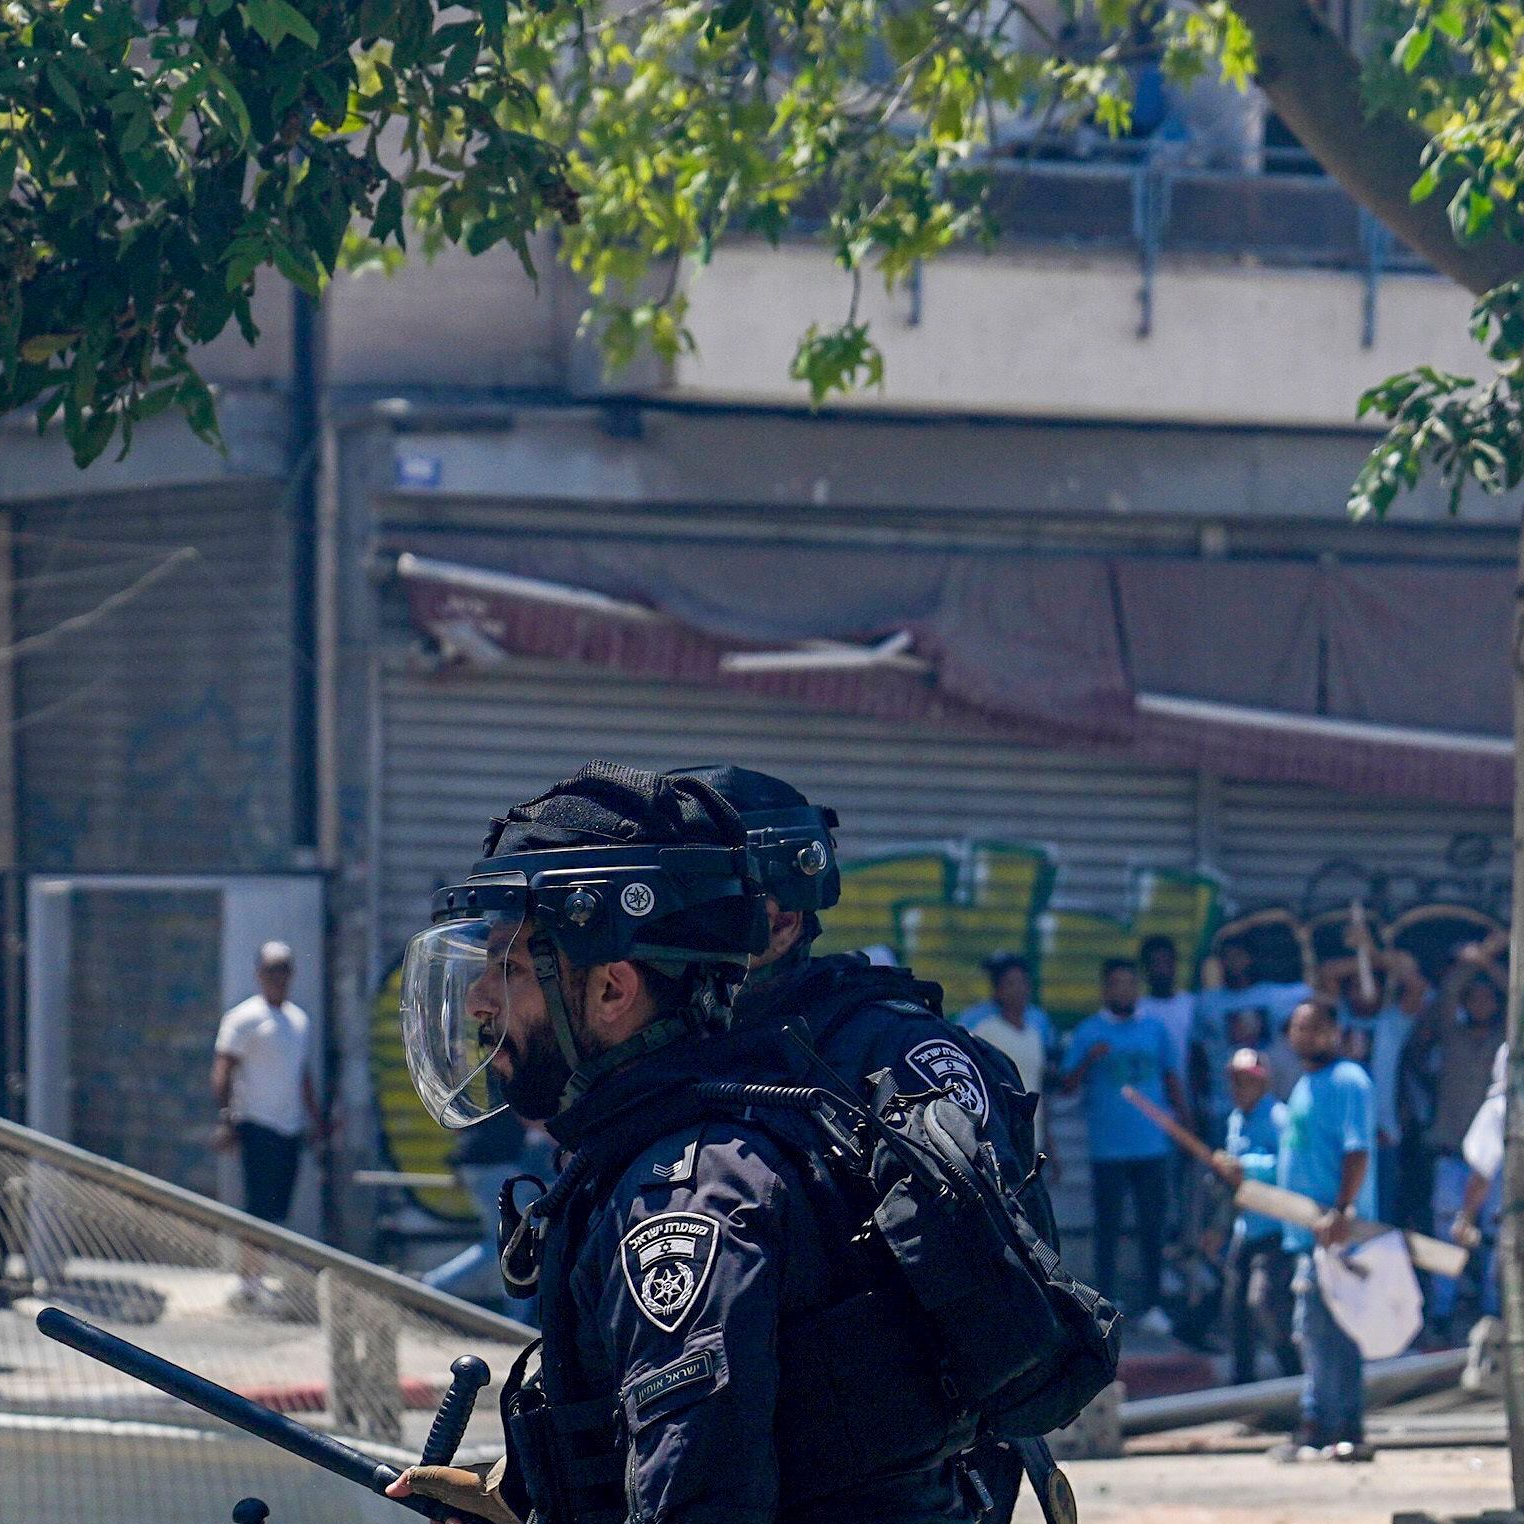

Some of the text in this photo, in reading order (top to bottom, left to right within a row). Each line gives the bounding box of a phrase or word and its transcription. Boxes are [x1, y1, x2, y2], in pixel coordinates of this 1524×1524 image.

[629, 1222, 709, 1250] משטרת ישראל
[665, 1363, 700, 1383] ישראל
